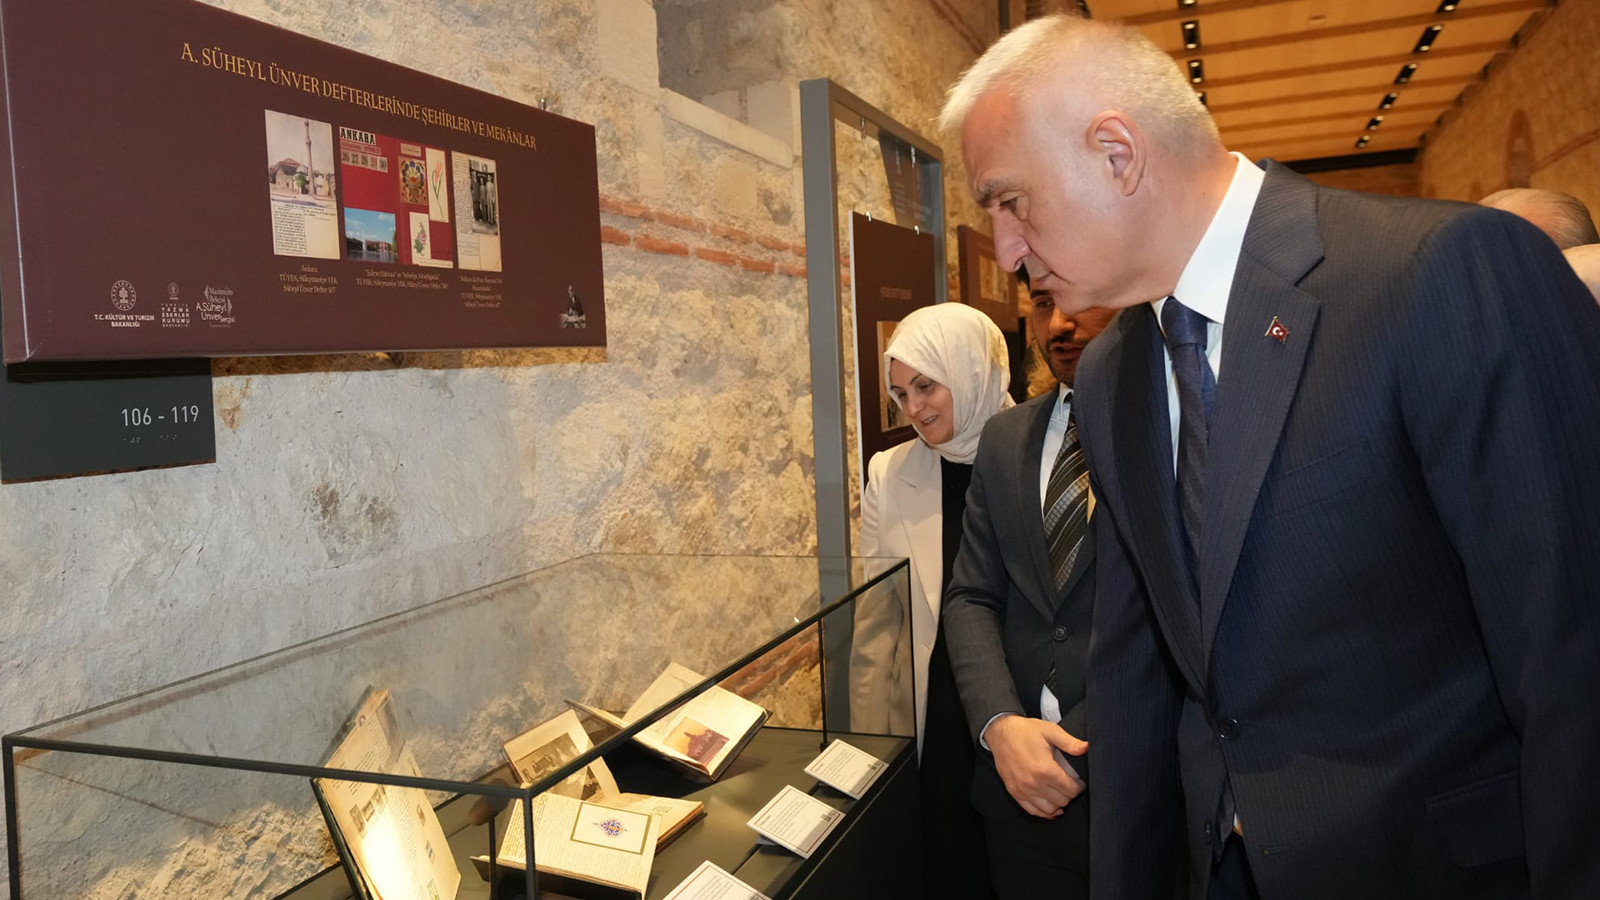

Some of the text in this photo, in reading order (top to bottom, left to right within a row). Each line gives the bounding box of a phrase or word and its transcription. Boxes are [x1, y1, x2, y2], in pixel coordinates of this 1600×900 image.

[181, 42, 537, 150] A. SÜHEYL ÜNVER DEFTERLERİNDE ŞEHİRLER VE MEKÂNLAR
[340, 127, 375, 145] ANKARA
[105, 313, 126, 321] KÜLTÜR
[121, 407, 152, 427] 106
[171, 404, 199, 424] 119
